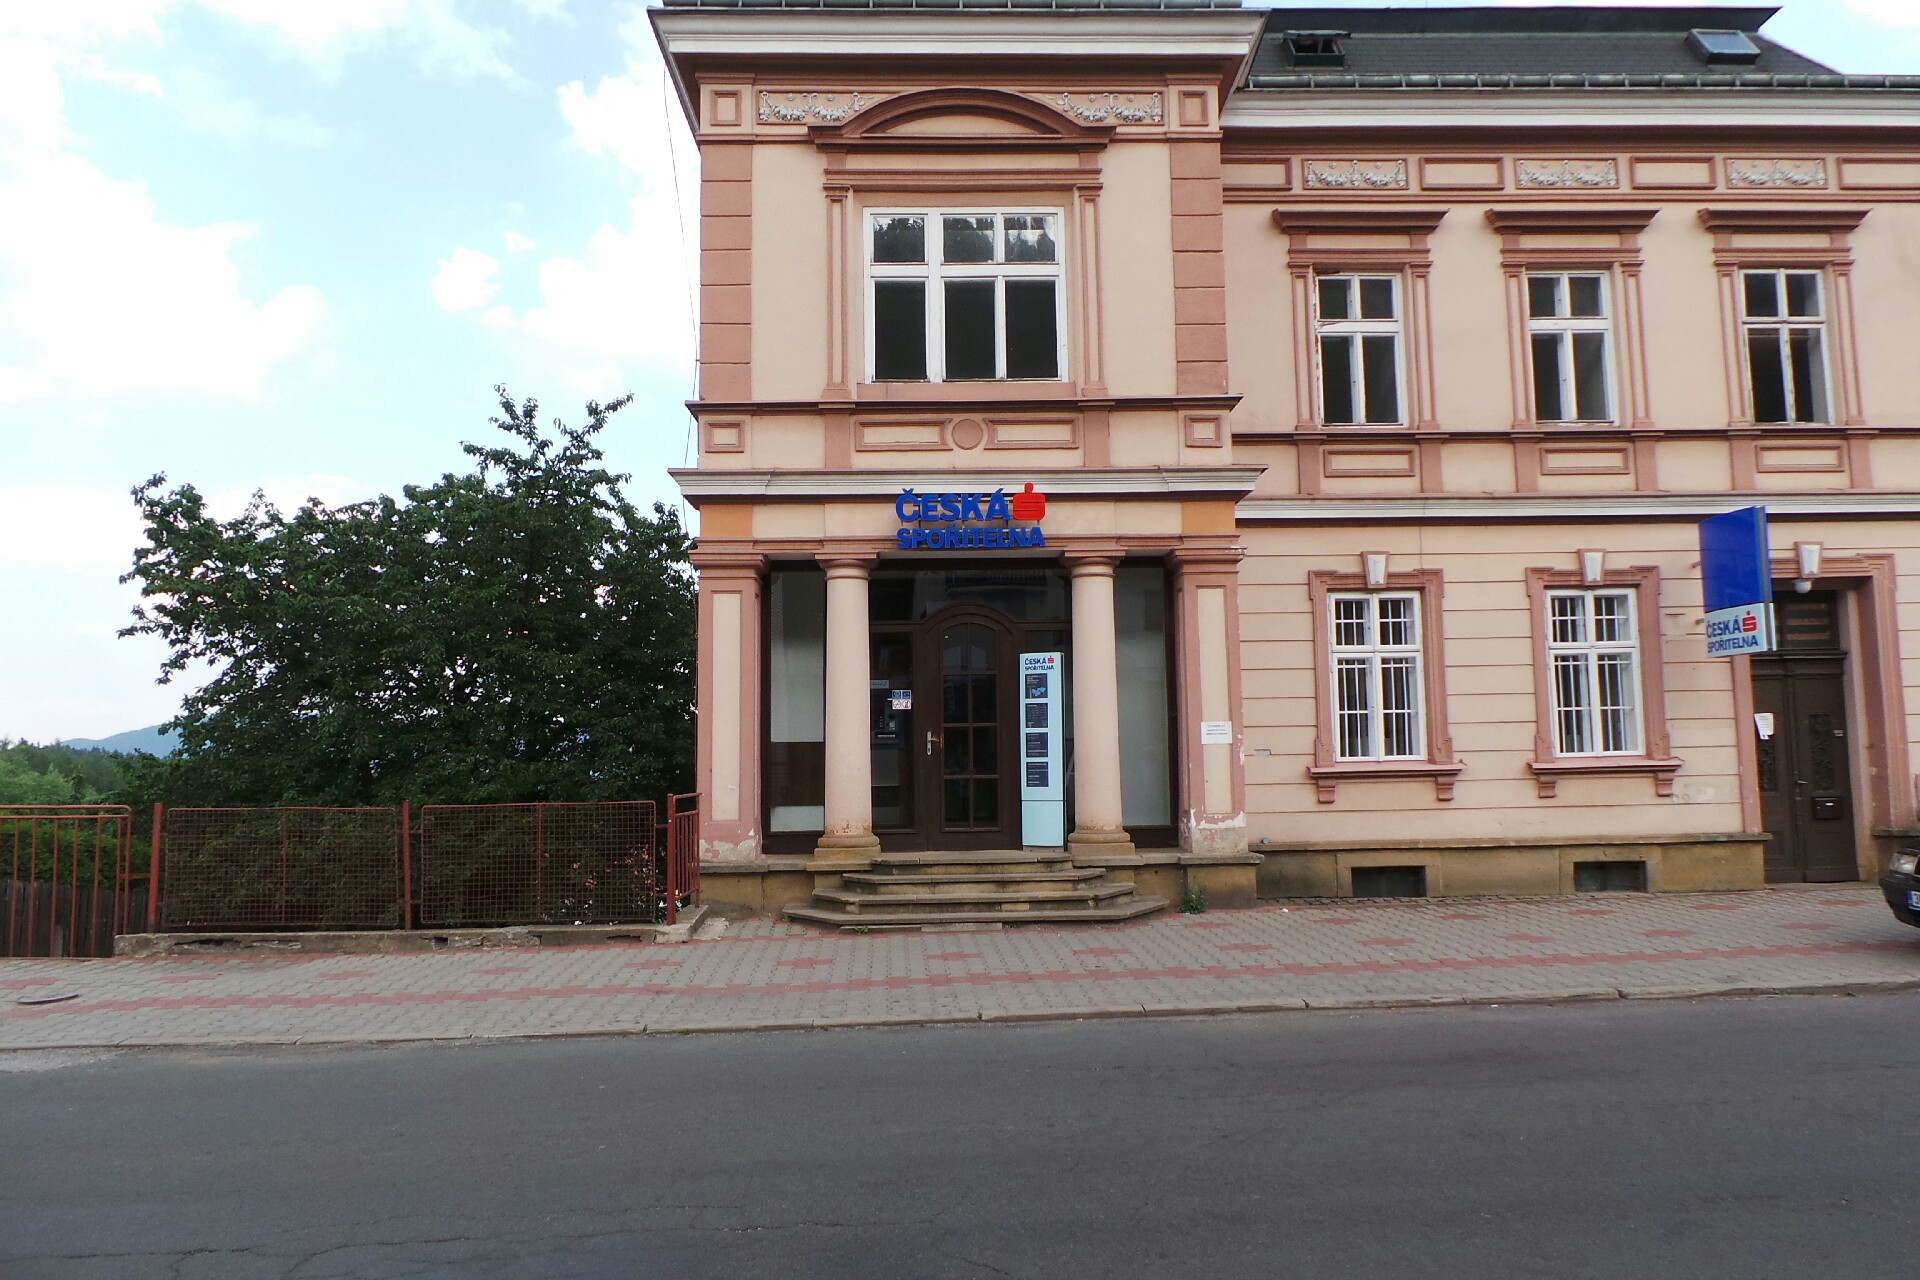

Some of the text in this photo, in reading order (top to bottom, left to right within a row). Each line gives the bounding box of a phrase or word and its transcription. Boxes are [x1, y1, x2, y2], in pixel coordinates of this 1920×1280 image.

[896, 488, 1010, 522] ČESKÁ
[896, 524, 1046, 549] SPOŘITELNA
[1706, 614, 1742, 638] ČESKÁ
[1707, 635, 1759, 653] SPOŘITELNA
[1024, 657, 1047, 665] ČESKÁ
